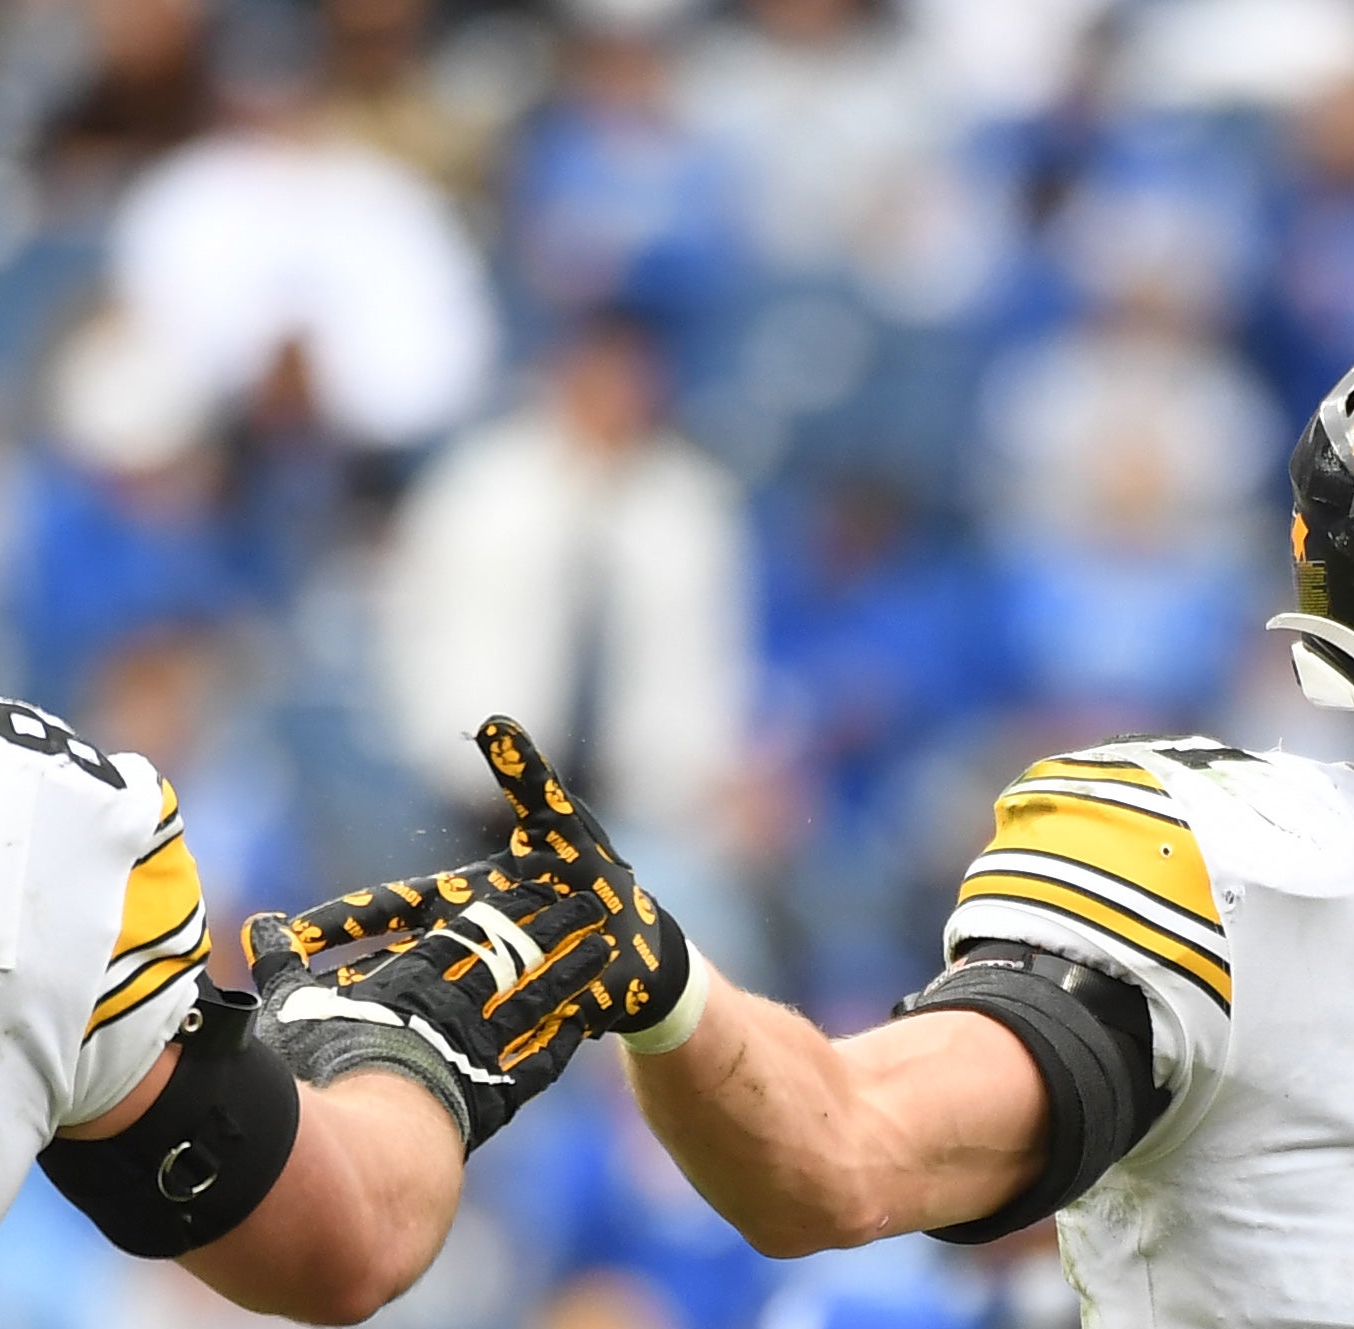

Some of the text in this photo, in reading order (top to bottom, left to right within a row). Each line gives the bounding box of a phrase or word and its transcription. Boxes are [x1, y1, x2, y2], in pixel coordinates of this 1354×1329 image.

[546, 830, 580, 864] IOWA
[593, 877, 624, 915] IOWA
[633, 933, 660, 972] IOWA
